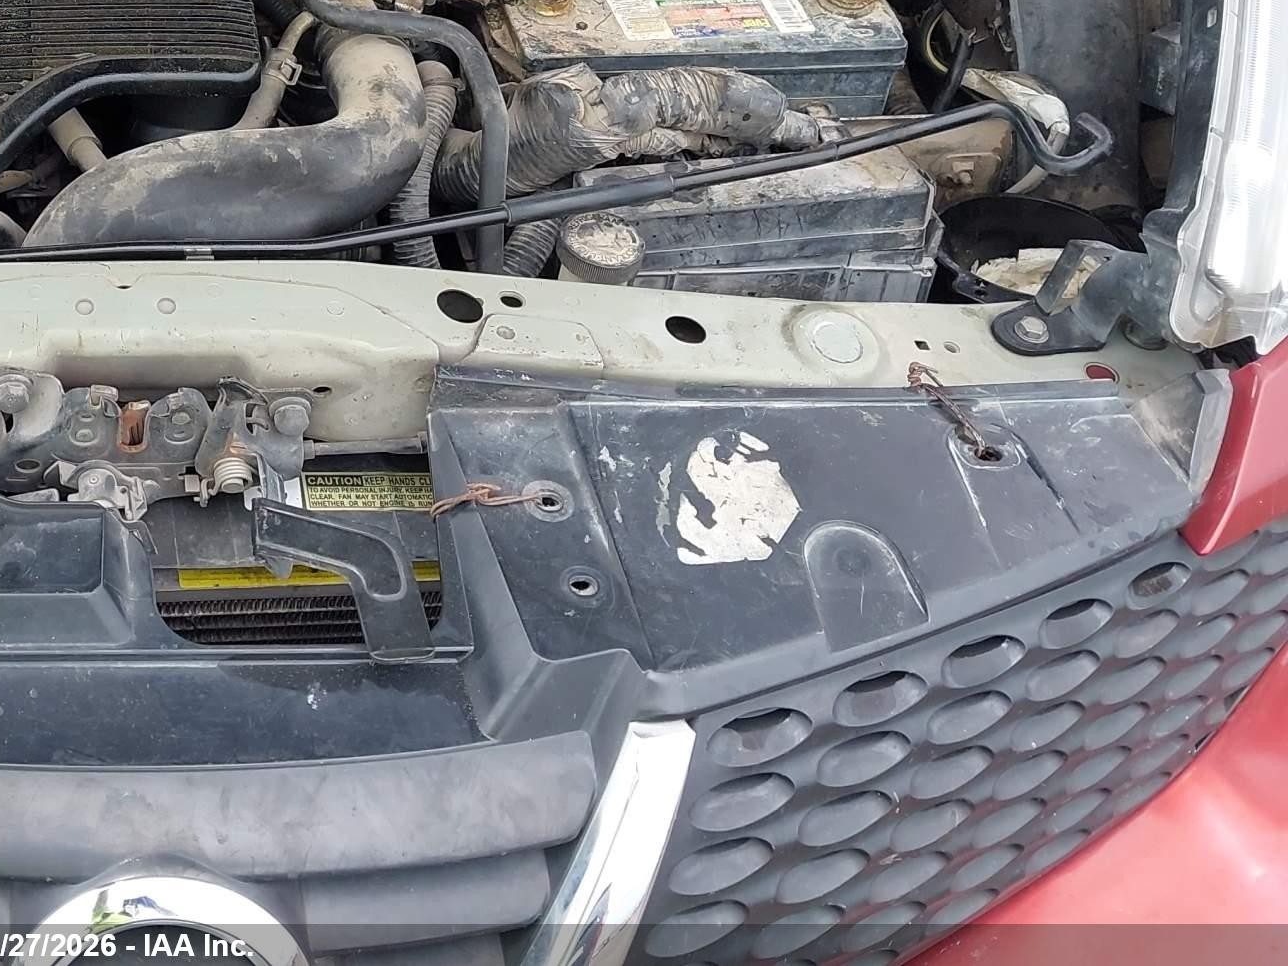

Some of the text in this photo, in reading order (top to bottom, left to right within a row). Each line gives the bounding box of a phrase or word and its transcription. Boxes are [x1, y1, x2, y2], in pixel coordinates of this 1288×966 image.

[307, 476, 432, 485] CAUTION KEEP HANDS CL
